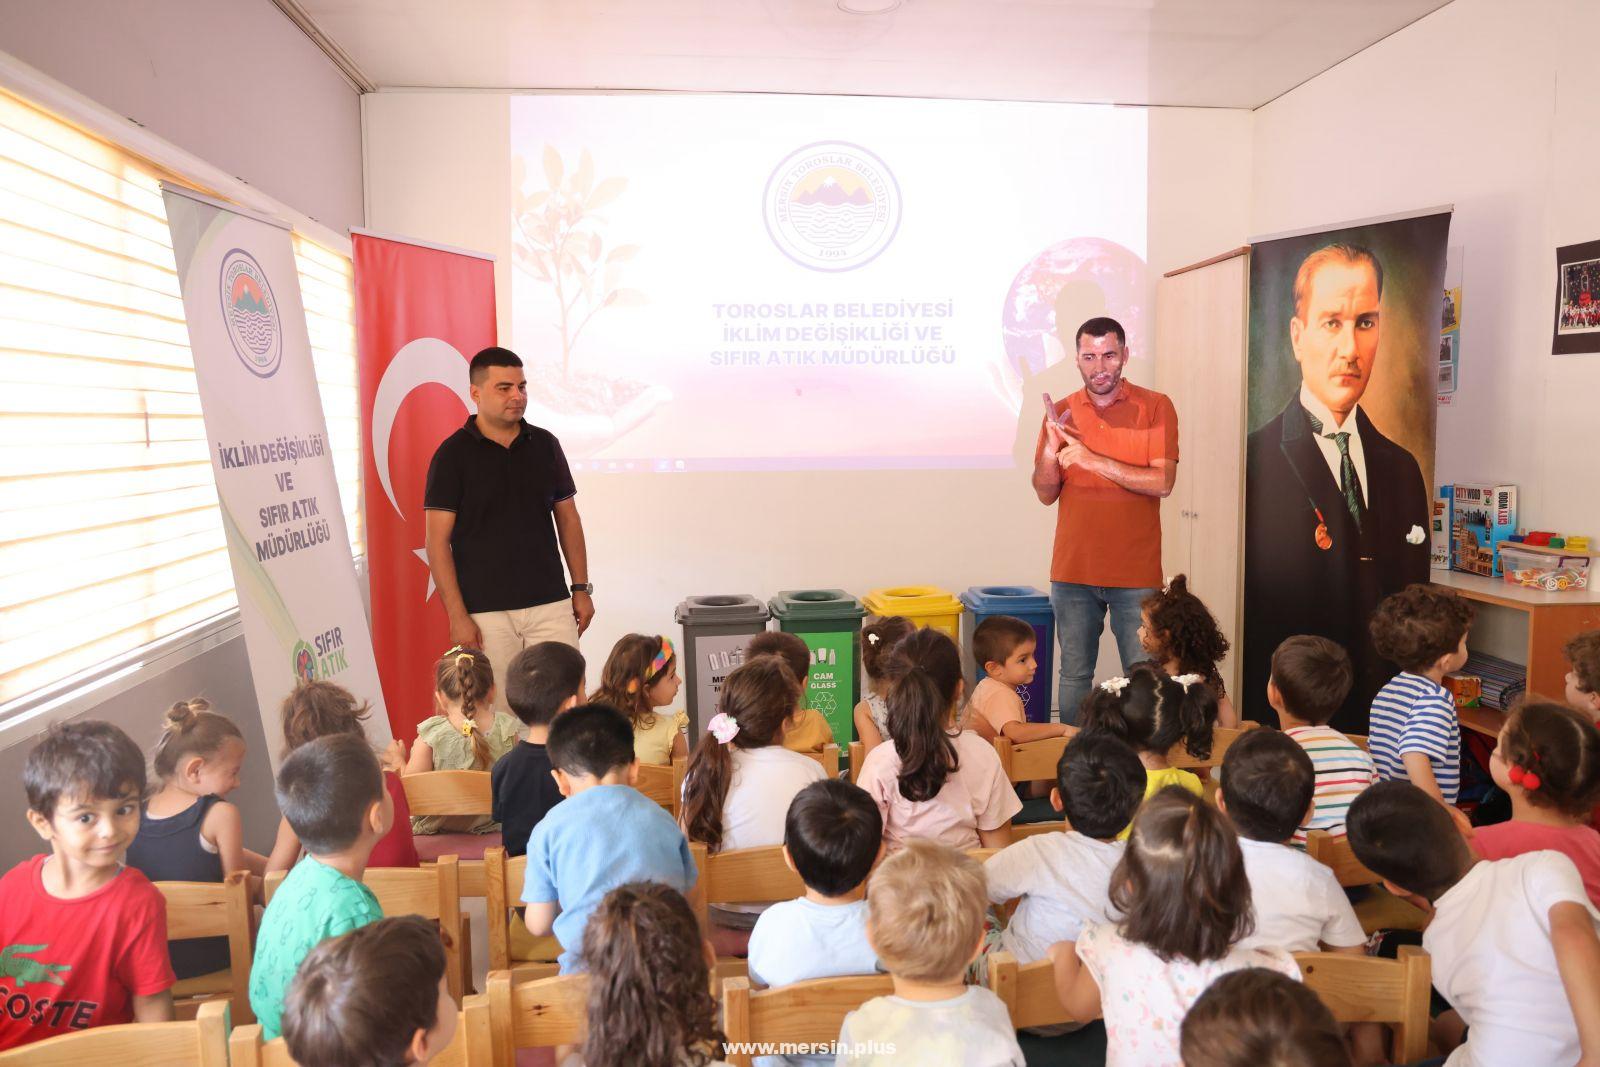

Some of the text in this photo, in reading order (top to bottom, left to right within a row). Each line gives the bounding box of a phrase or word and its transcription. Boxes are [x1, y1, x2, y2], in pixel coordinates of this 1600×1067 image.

[791, 155, 852, 178] TOROSLAR
[712, 298, 954, 318] TOROSLAR BELEDİYESİ
[723, 322, 943, 346] İKLİM DEĞİŞİKLİĞİ VE
[710, 345, 956, 365] SIFIR ATIK MÜDÜRLÜĞÜ
[218, 433, 325, 469] İKLİM DEĞİŞİKLİĞİ
[275, 471, 294, 492] VE
[258, 496, 320, 528] SIFIR ATIK
[1498, 491, 1508, 526] CITY WOOD
[255, 518, 331, 562] MÜDÜRLÜĞÜ
[314, 626, 344, 657] SIFIR
[321, 647, 348, 680] ATIK
[813, 672, 834, 680] CAM
